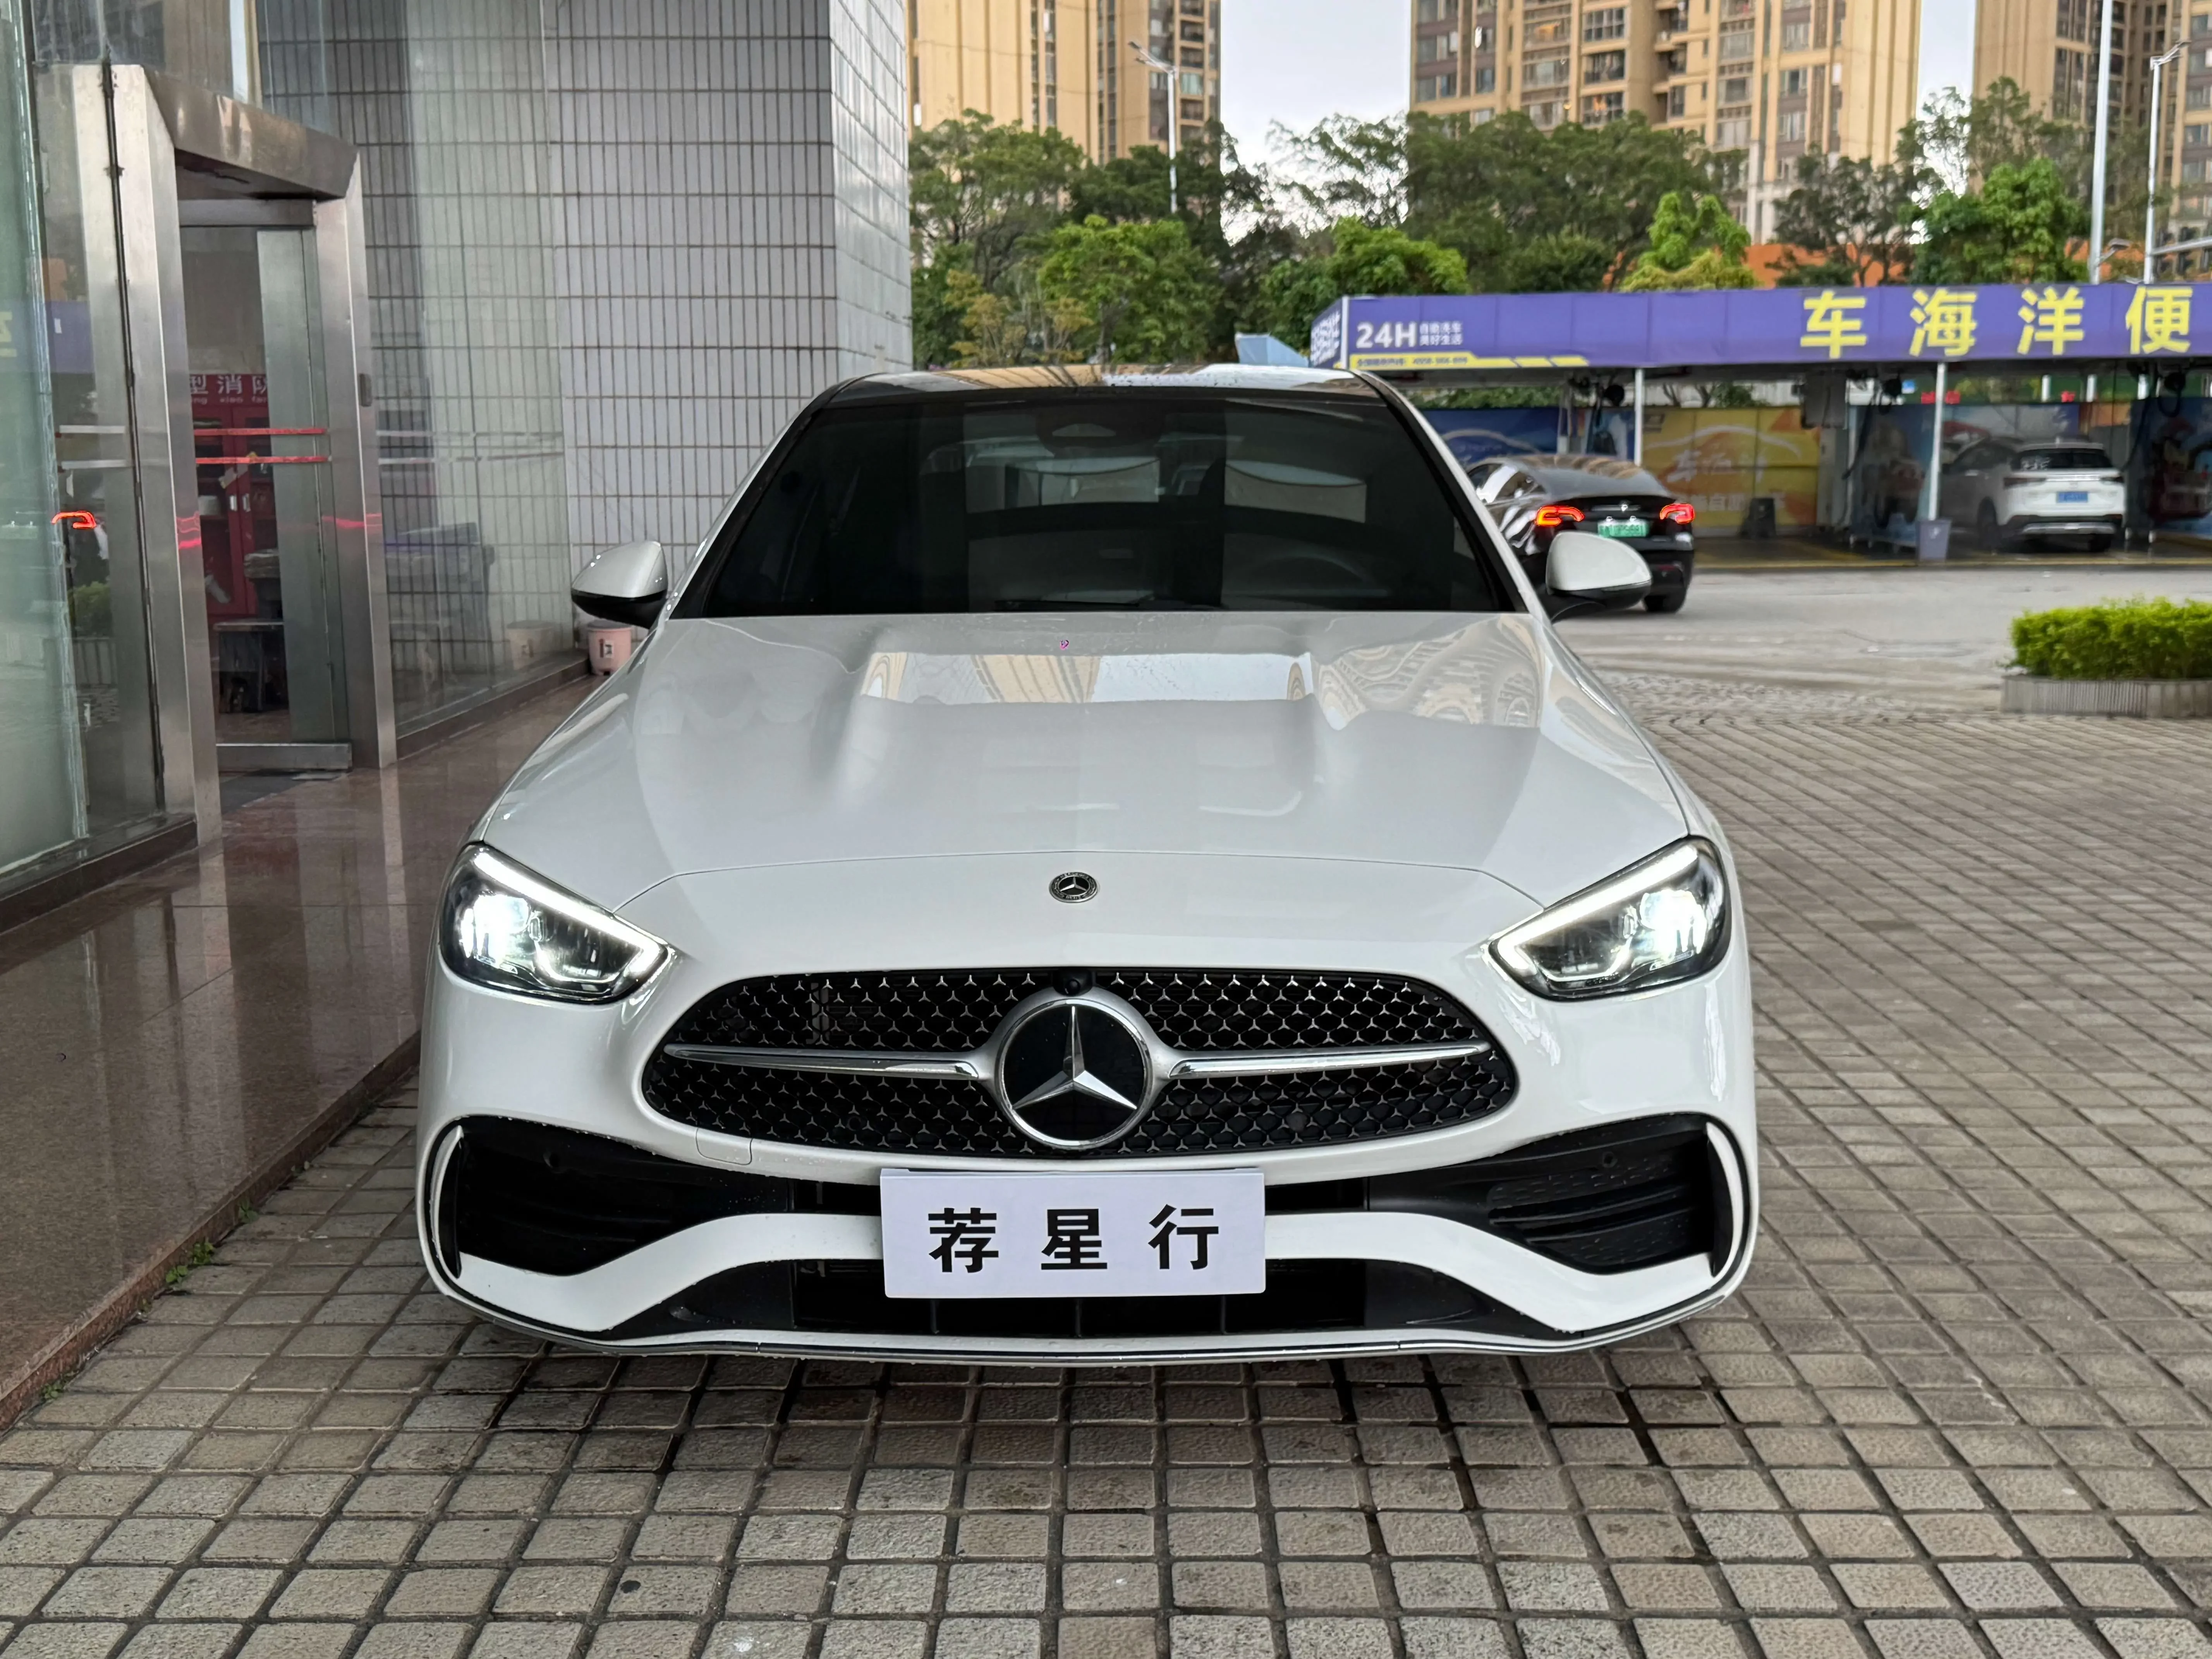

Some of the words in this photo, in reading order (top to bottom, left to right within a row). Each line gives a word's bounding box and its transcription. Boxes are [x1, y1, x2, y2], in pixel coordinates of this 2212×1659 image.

[1356, 321, 1417, 349] 24H
[1800, 287, 2193, 359] 车海洋便
[928, 1204, 1219, 1273] 荐星行
